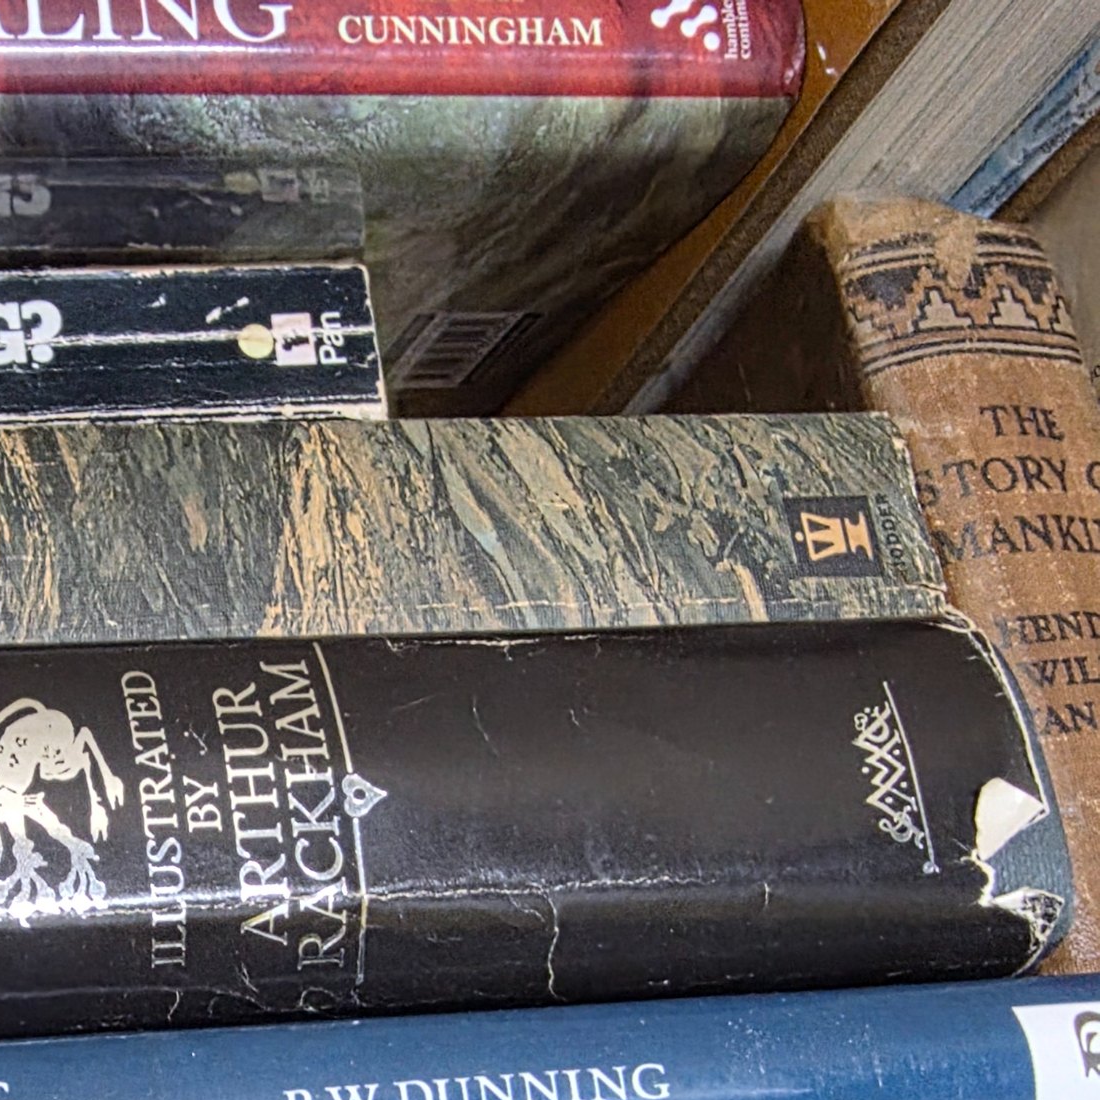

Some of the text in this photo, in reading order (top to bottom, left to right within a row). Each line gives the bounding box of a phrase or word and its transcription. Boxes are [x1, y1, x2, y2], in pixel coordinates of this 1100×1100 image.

[338, 14, 604, 46] CUNNINGHAM
[319, 312, 348, 364] Pan
[980, 405, 1064, 441] THE
[916, 454, 1068, 507] STORY
[932, 513, 1100, 560] MANKI
[1034, 702, 1100, 737] AN
[120, 669, 188, 969] ILLUSTRATED
[182, 775, 224, 833] BY
[211, 681, 292, 947] ARTHUR
[259, 658, 349, 971] RACKHAM
